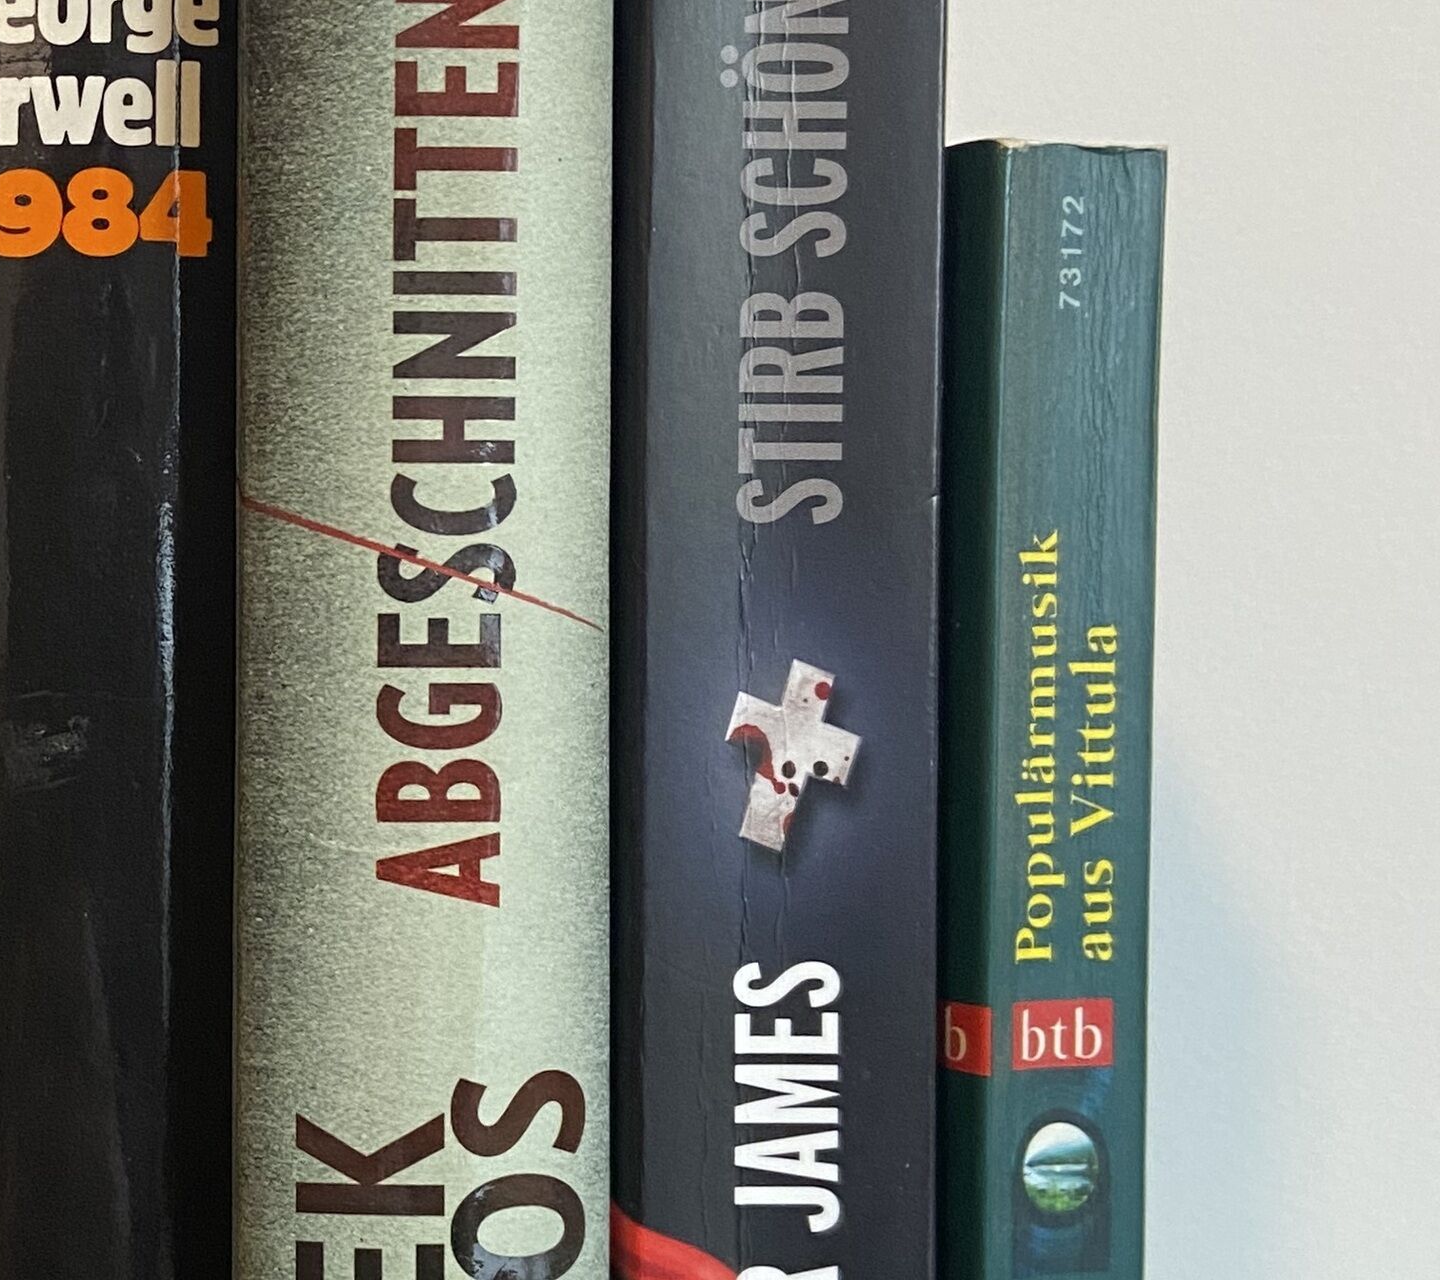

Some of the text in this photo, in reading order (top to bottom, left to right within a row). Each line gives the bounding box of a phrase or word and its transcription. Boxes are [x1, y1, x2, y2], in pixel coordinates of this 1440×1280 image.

[1059, 195, 1085, 309] 73172
[736, 294, 844, 525] STIRB
[1015, 529, 1066, 964] Populärmusik
[1068, 623, 1119, 961] aus Vittula
[732, 961, 842, 1235] JAMES
[1022, 1006, 1103, 1062] btb
